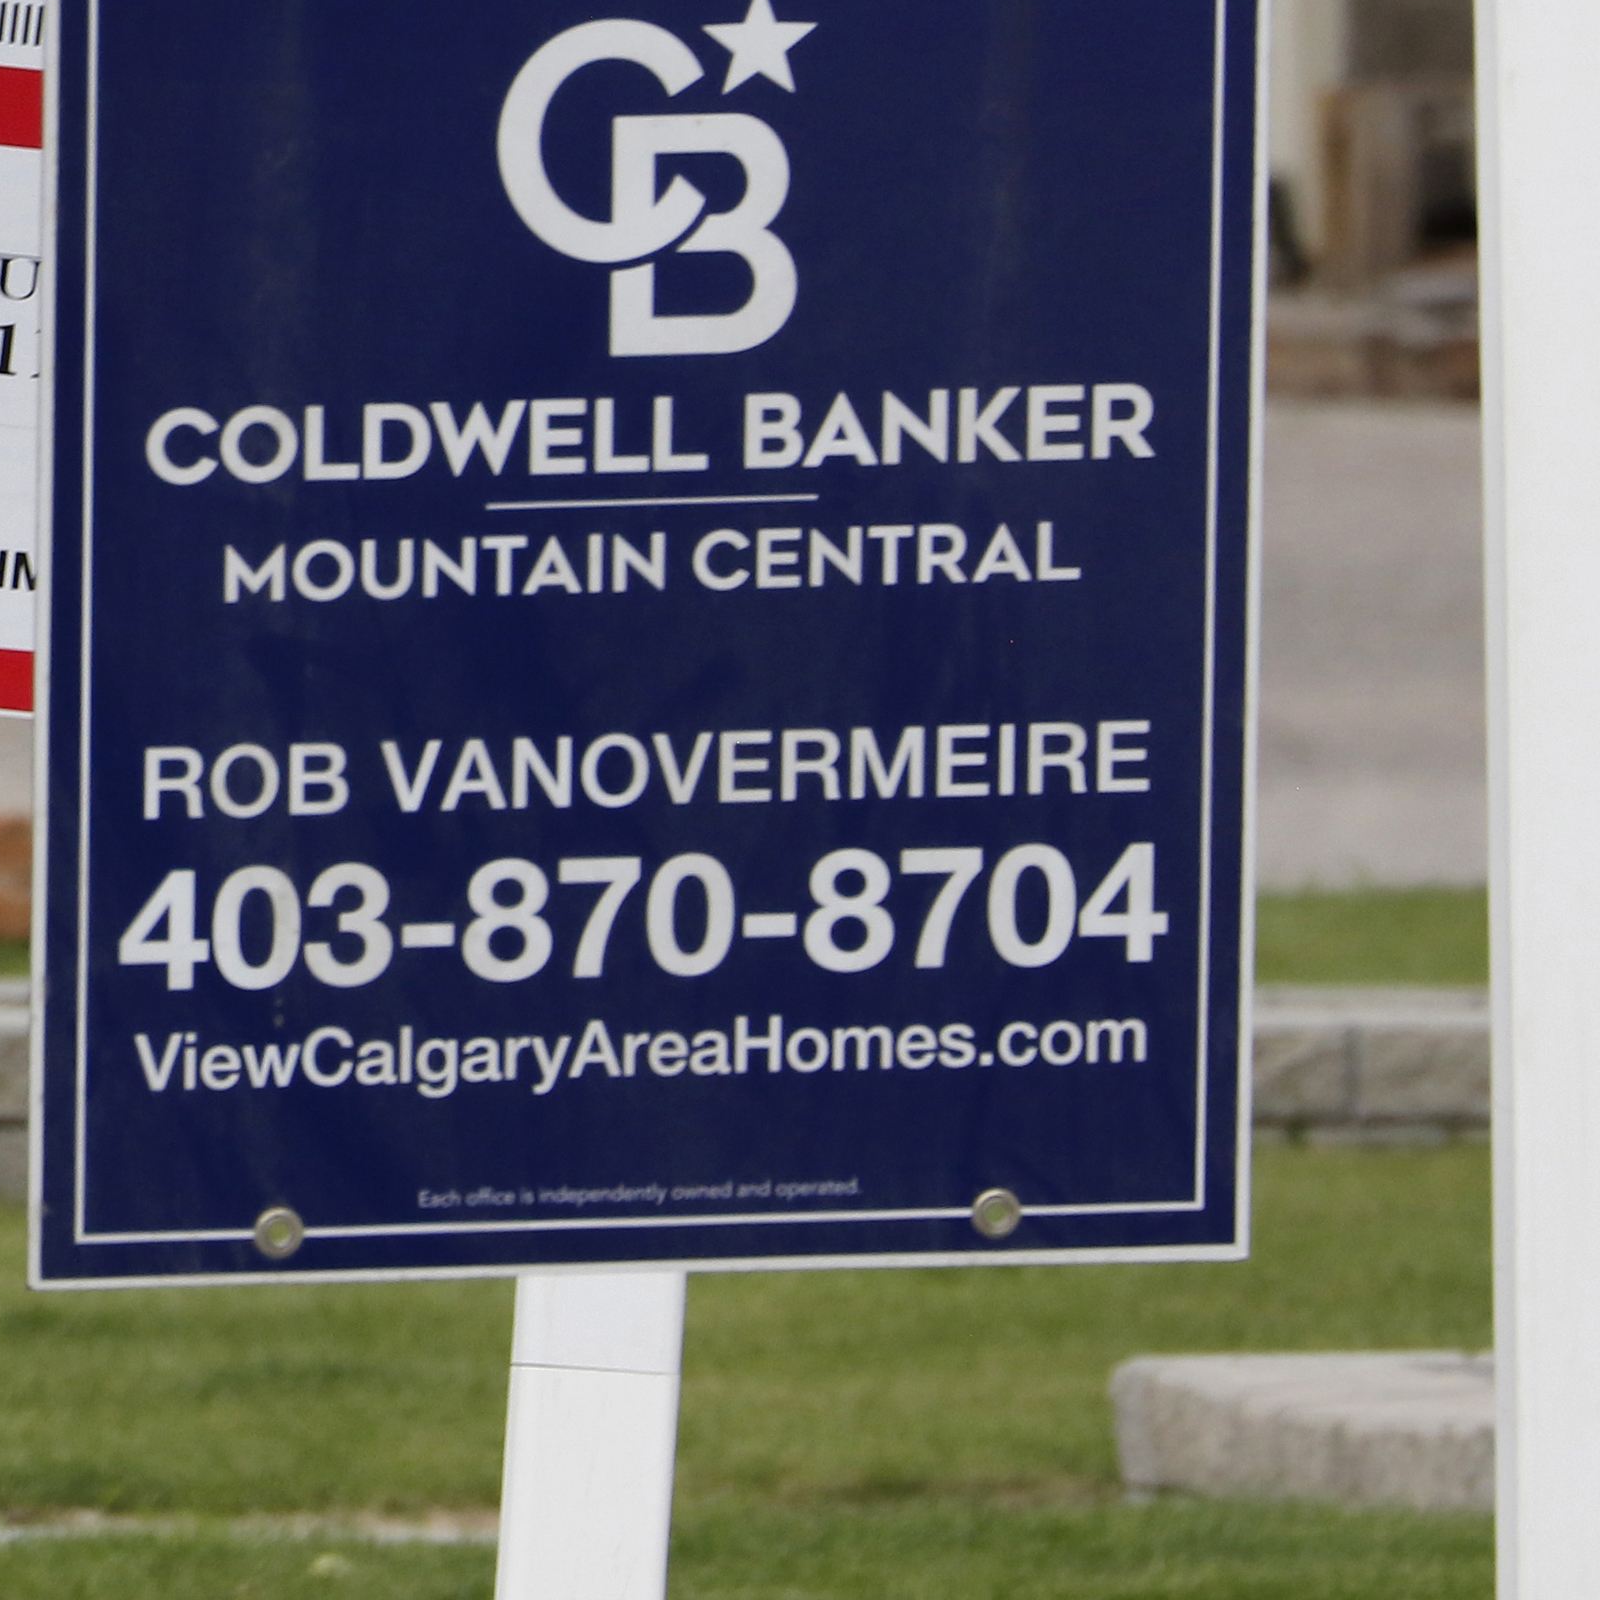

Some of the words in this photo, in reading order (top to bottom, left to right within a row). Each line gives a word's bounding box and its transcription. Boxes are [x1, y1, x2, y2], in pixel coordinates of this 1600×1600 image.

[145, 395, 709, 486] COLDWELL
[744, 383, 1155, 469] BANKER
[224, 531, 666, 604] MOUNTAIN
[692, 521, 1081, 591] CENTRAL
[143, 743, 349, 820] ROB
[381, 719, 1150, 812] VANOVERMEIRE
[118, 842, 1169, 991] 403-870-8704
[134, 1014, 1147, 1098] ViewCalgaryAreaHomes.com
[417, 1188, 462, 1208] Each
[464, 1186, 516, 1206] office
[538, 1182, 667, 1206] independently
[670, 1178, 733, 1200] owned
[736, 1179, 771, 1198] and
